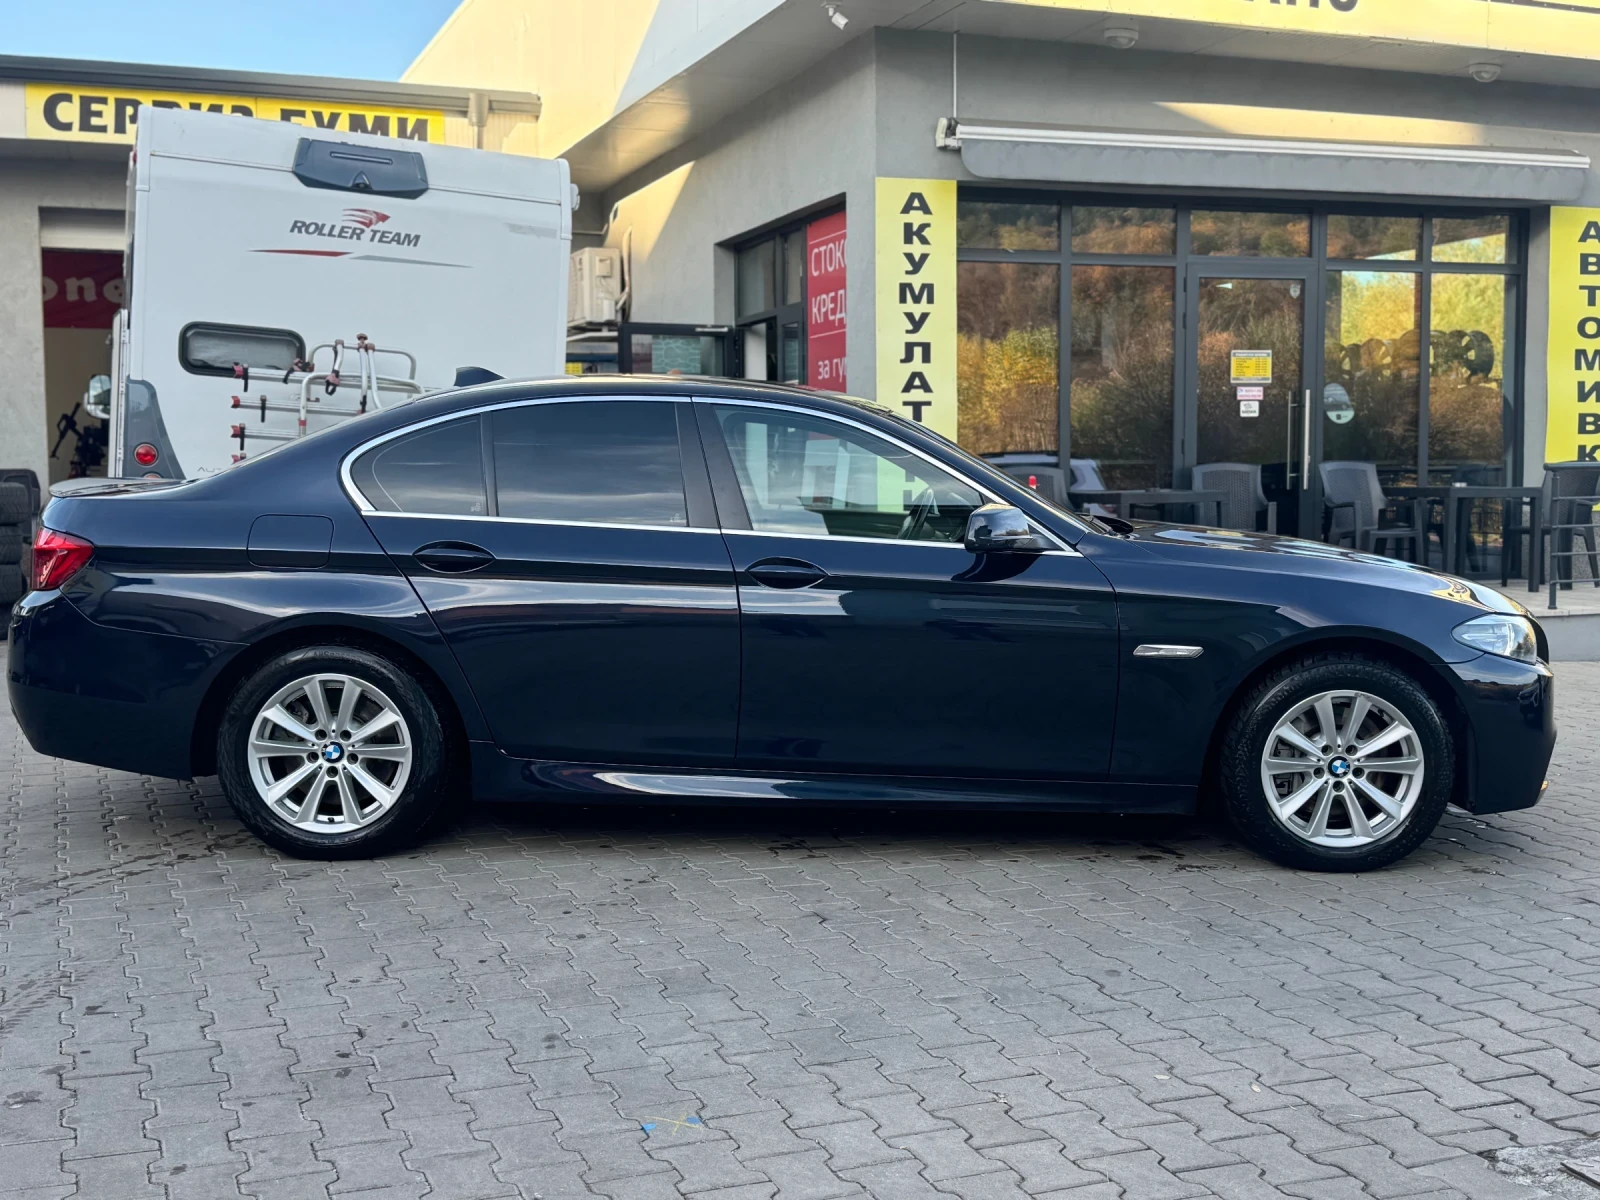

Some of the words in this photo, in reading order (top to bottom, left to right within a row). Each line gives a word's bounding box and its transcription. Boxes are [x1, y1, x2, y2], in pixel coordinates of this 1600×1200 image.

[43, 92, 254, 134] СЕР
[289, 219, 365, 241] ROLLER
[369, 228, 421, 248] TEAM
[811, 238, 847, 277] СТОК
[899, 191, 935, 423] АКУМУЛАТ
[817, 361, 830, 380] за
[832, 356, 847, 383] гу
